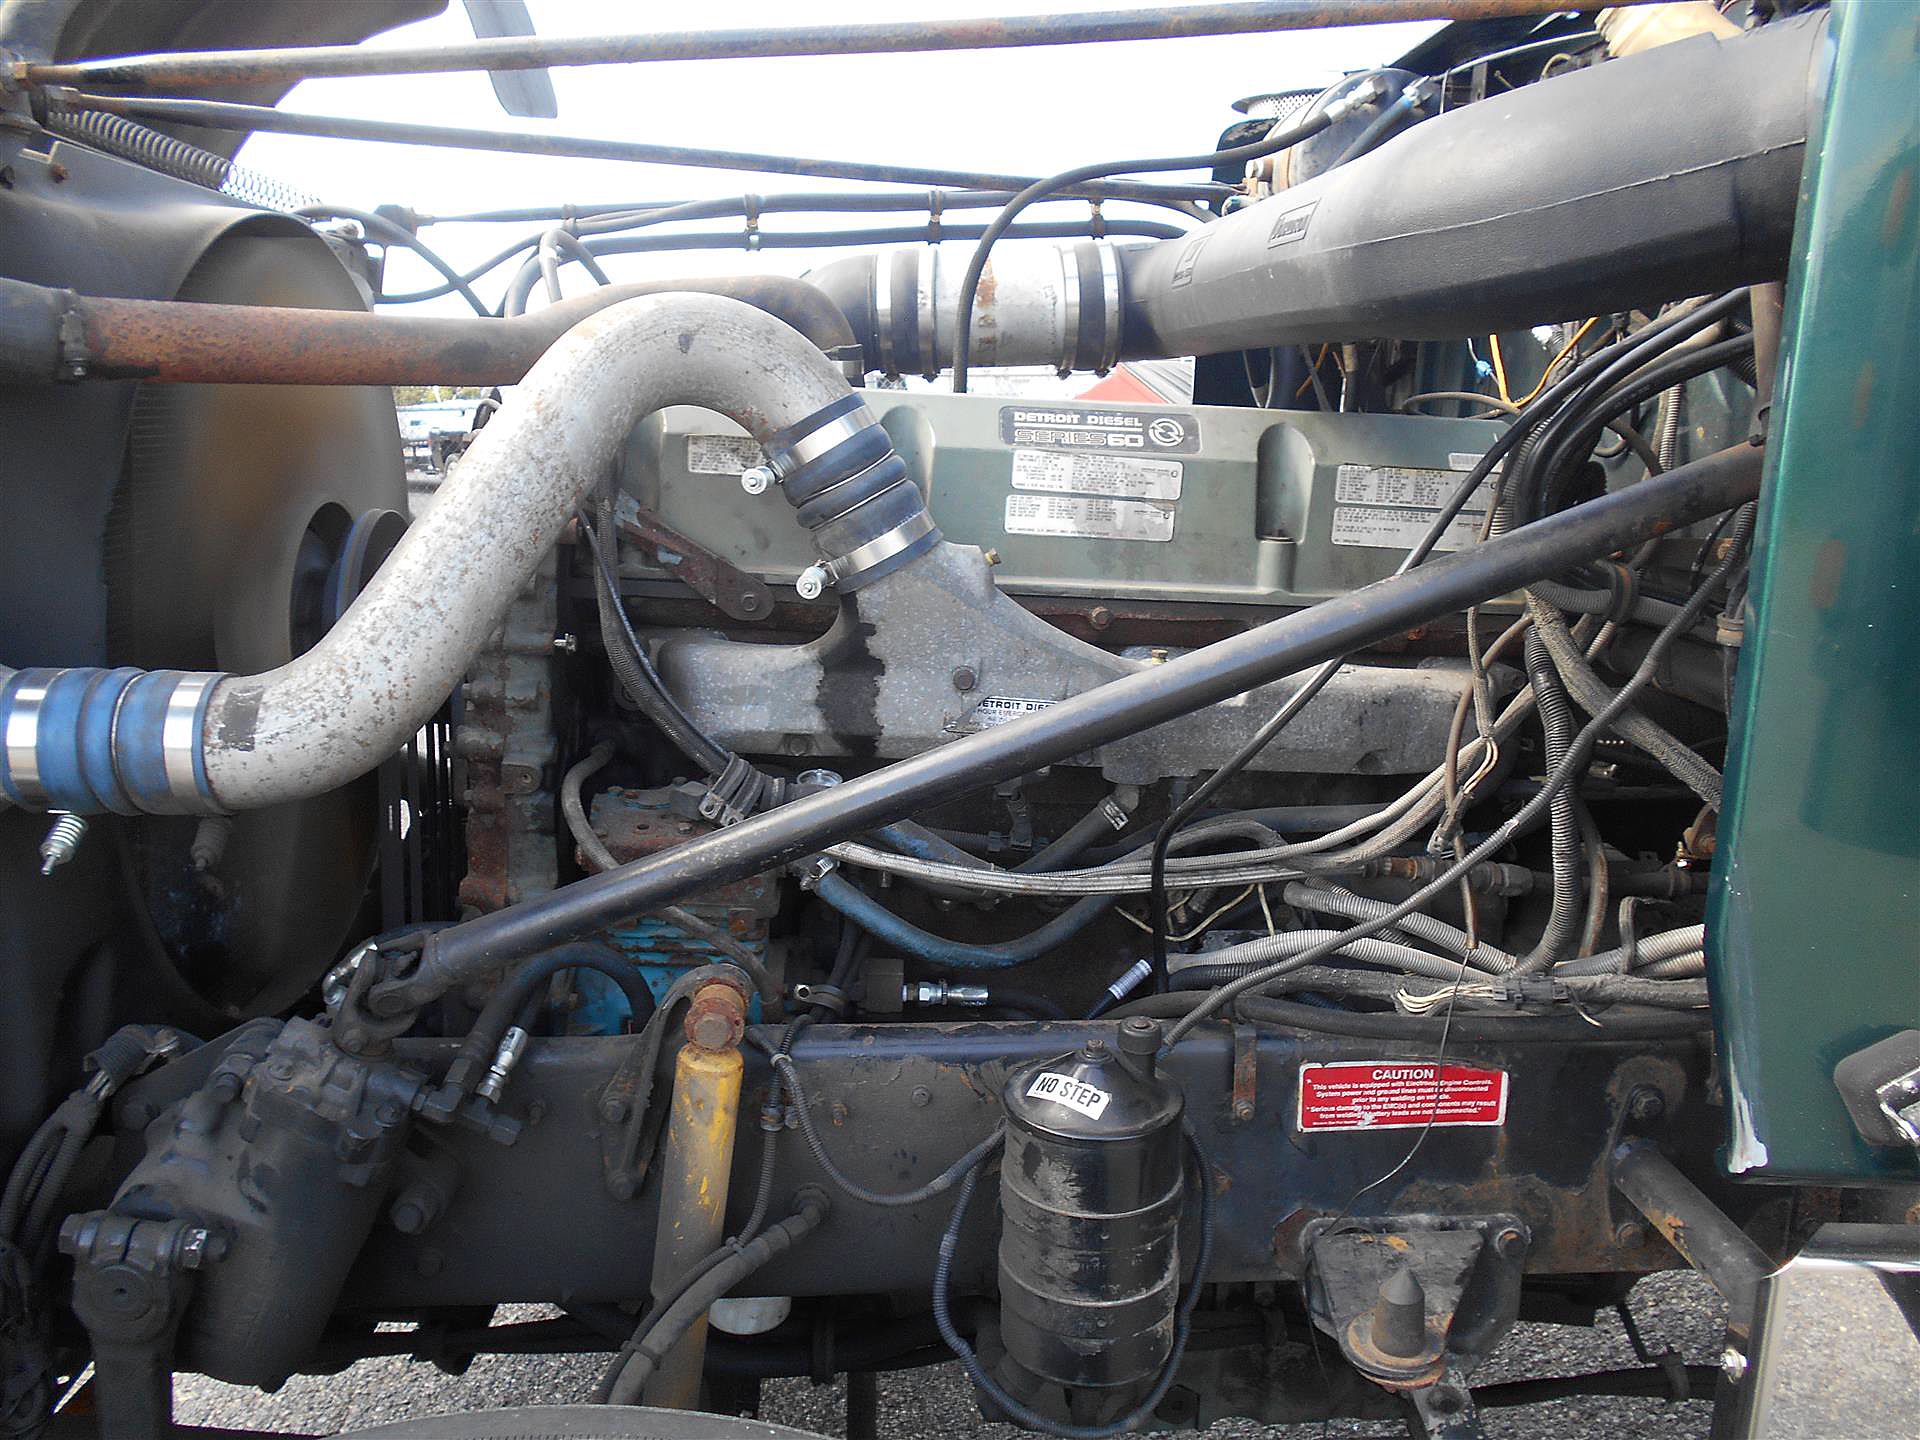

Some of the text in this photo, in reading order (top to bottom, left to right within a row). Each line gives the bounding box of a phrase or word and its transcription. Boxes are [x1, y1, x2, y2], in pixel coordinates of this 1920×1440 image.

[1014, 411, 1143, 427] DETROIT DIESEL
[1372, 1069, 1434, 1080] CAUTION
[1036, 1076, 1102, 1108] NO STEP
